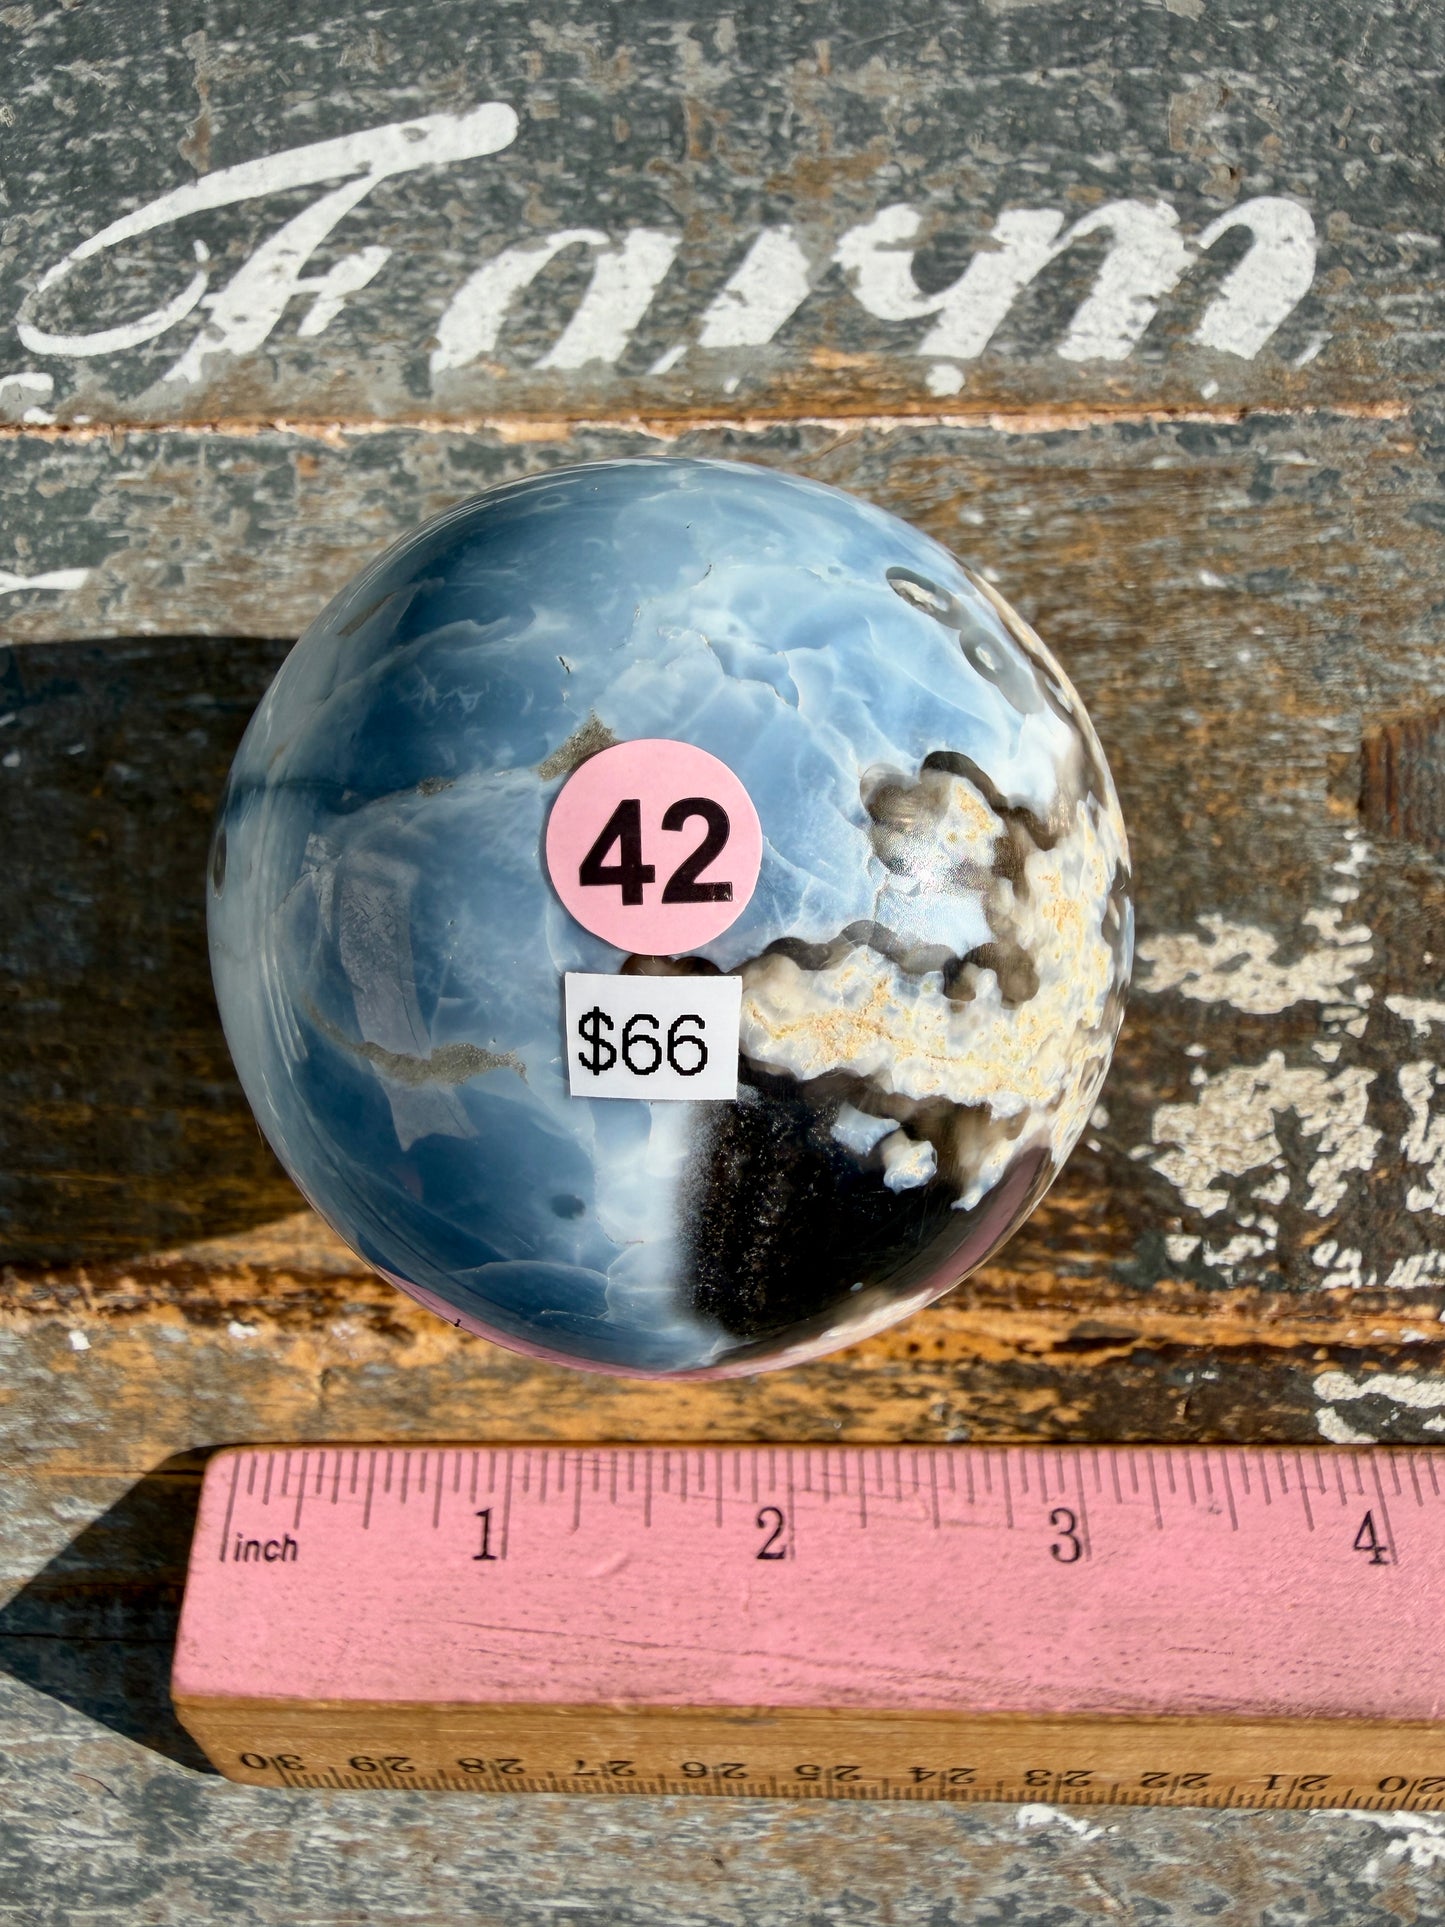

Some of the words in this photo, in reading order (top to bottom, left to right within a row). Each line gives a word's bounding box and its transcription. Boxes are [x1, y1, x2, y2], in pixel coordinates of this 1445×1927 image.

[579, 797, 733, 905] 42
[578, 1006, 708, 1076] $66
[233, 1533, 298, 1562] inch
[471, 1507, 498, 1561] 1
[756, 1507, 786, 1560] 2
[1050, 1507, 1082, 1563] 3
[1353, 1510, 1389, 1565] 4
[239, 1752, 306, 1771] 30
[349, 1756, 415, 1773] 29
[457, 1757, 525, 1775] 28
[573, 1760, 636, 1777] 27
[680, 1761, 747, 1779] 26
[793, 1764, 861, 1782] 25
[907, 1766, 976, 1784] 24
[1024, 1768, 1094, 1787] 23
[1139, 1771, 1212, 1789] 22
[1263, 1773, 1332, 1792] 21
[1377, 1775, 1445, 1794] 20
